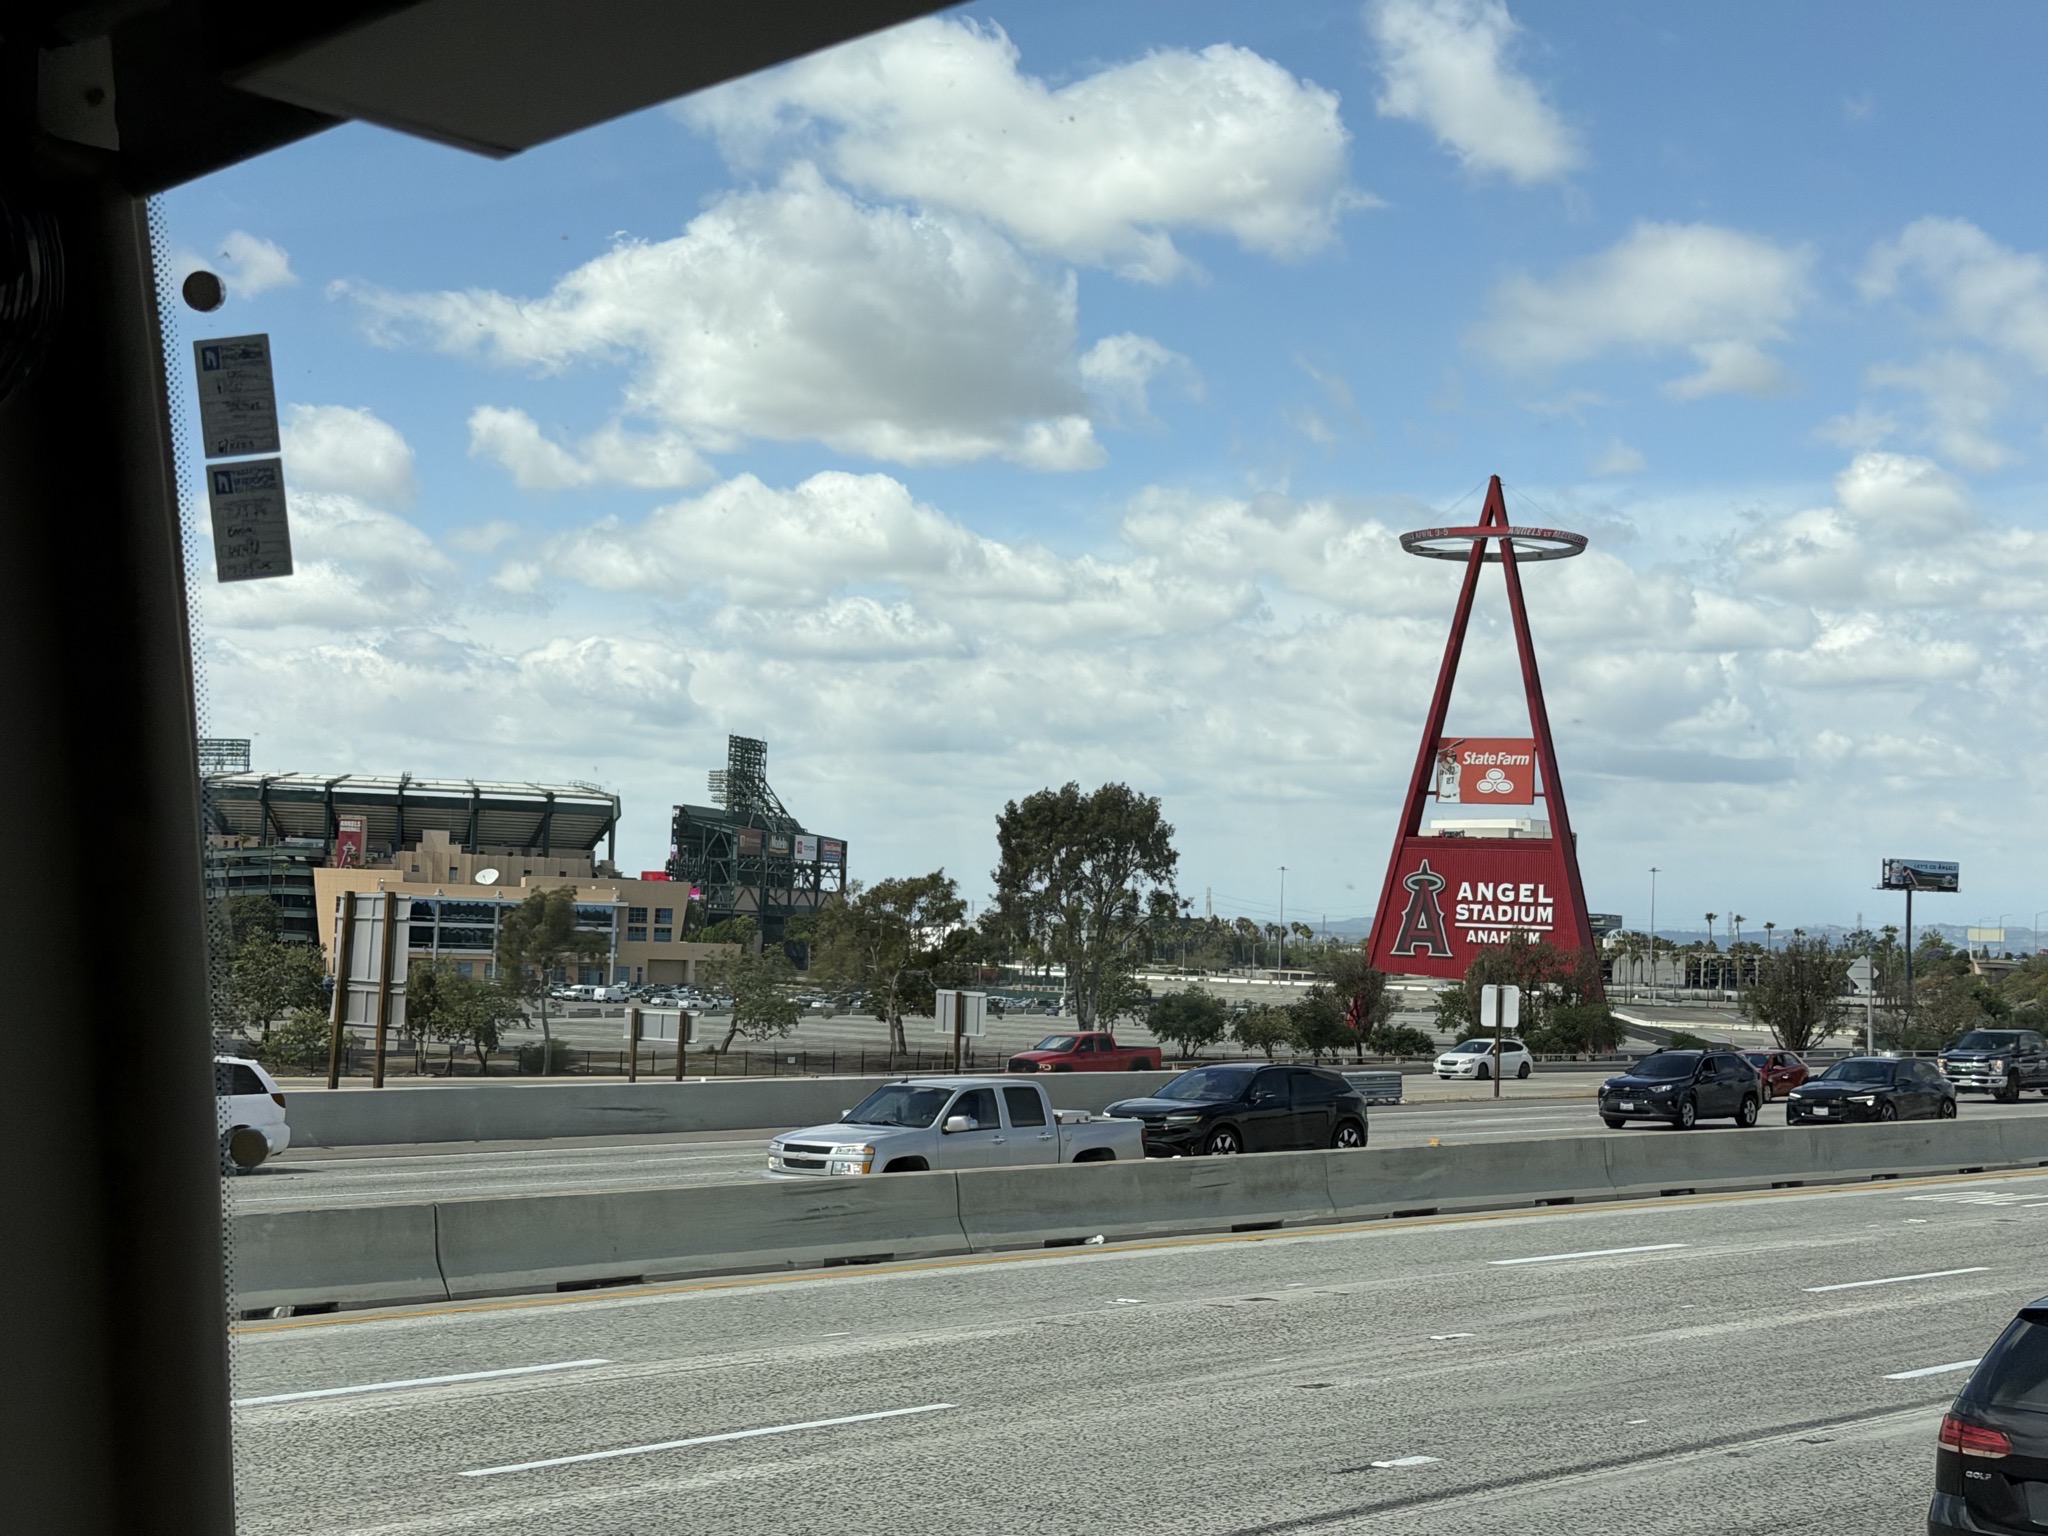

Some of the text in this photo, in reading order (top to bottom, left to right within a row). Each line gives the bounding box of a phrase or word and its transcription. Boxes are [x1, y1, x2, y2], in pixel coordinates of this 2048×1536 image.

[1462, 751, 1530, 766] State Farm
[1456, 881, 1554, 904] ANGEL
[1455, 903, 1553, 923] STADIUM
[1465, 929, 1541, 945] ANAHM
[1965, 1470, 1992, 1480] GOLF
